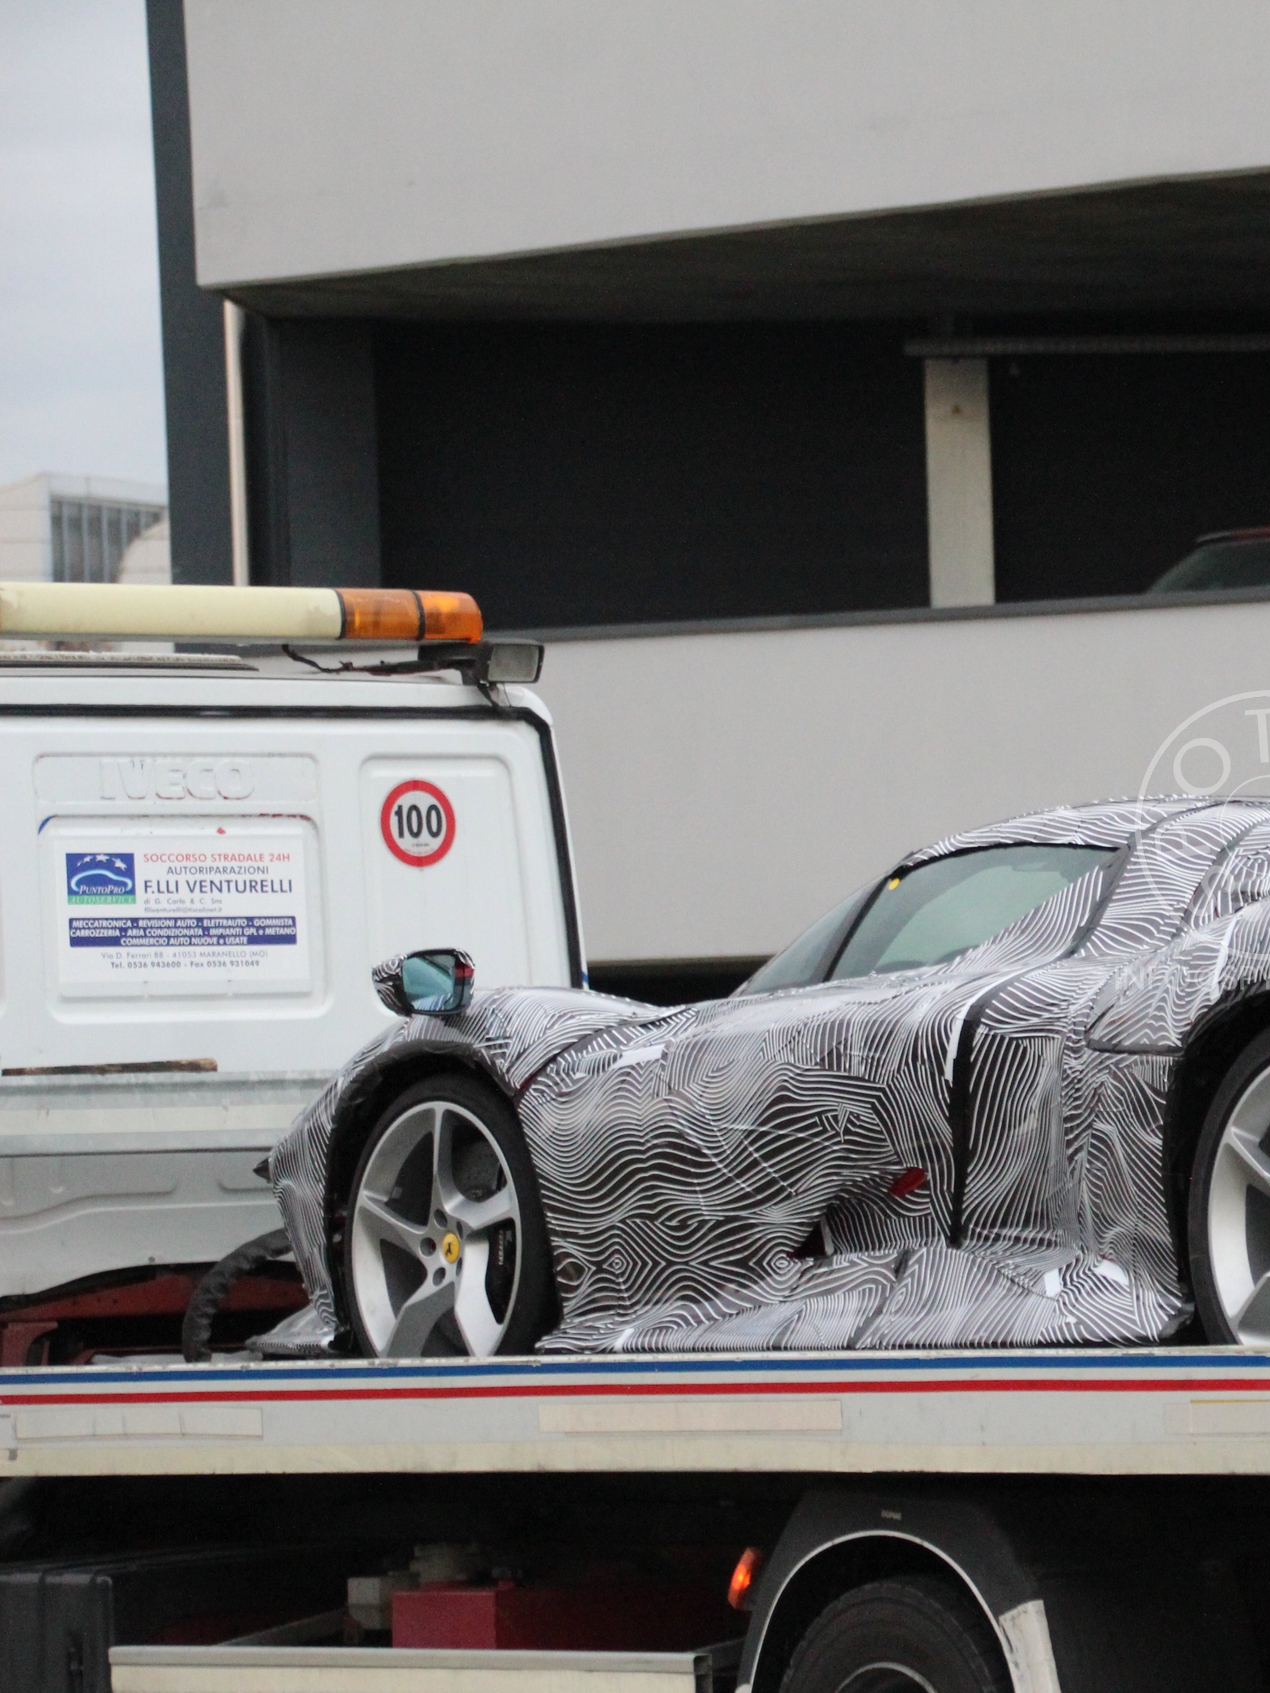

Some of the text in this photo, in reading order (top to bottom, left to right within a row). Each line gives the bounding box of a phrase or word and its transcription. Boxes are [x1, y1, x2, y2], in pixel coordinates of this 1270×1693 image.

[100, 759, 255, 800] IVECO
[394, 804, 443, 839] 100
[143, 853, 291, 863] SOCCORSO STRADALE 24H
[167, 866, 269, 875] AUTORIPARAZIONI
[144, 879, 293, 894] F.LLI VENTURELLI
[70, 895, 135, 904] AUTOSERVICE
[72, 920, 132, 928] MECCATRONICA
[138, 919, 175, 928] REVISIONI
[176, 919, 197, 927] AUTO
[203, 919, 248, 927] ELETTRAUTO
[253, 918, 293, 926] GOMMISTA
[70, 929, 120, 937] CARROZZERIA
[127, 929, 144, 937] ARIA
[146, 928, 203, 936] CONDIZIONATA
[209, 928, 242, 936] IMPIANTI
[243, 927, 257, 936] GPL
[265, 927, 296, 935] METANO
[121, 938, 168, 946] COMMERCIO
[191, 937, 218, 945] NUOVE
[225, 937, 248, 945] USATE
[101, 952, 114, 960] Via
[126, 951, 152, 960] Ferrari
[172, 951, 197, 959] 41053
[200, 950, 247, 958] MARANELLO
[249, 950, 269, 959] (MO)
[111, 961, 125, 969] Tel.
[127, 961, 148, 969] 0536
[190, 960, 204, 968] Fax
[206, 960, 227, 968] 0536
